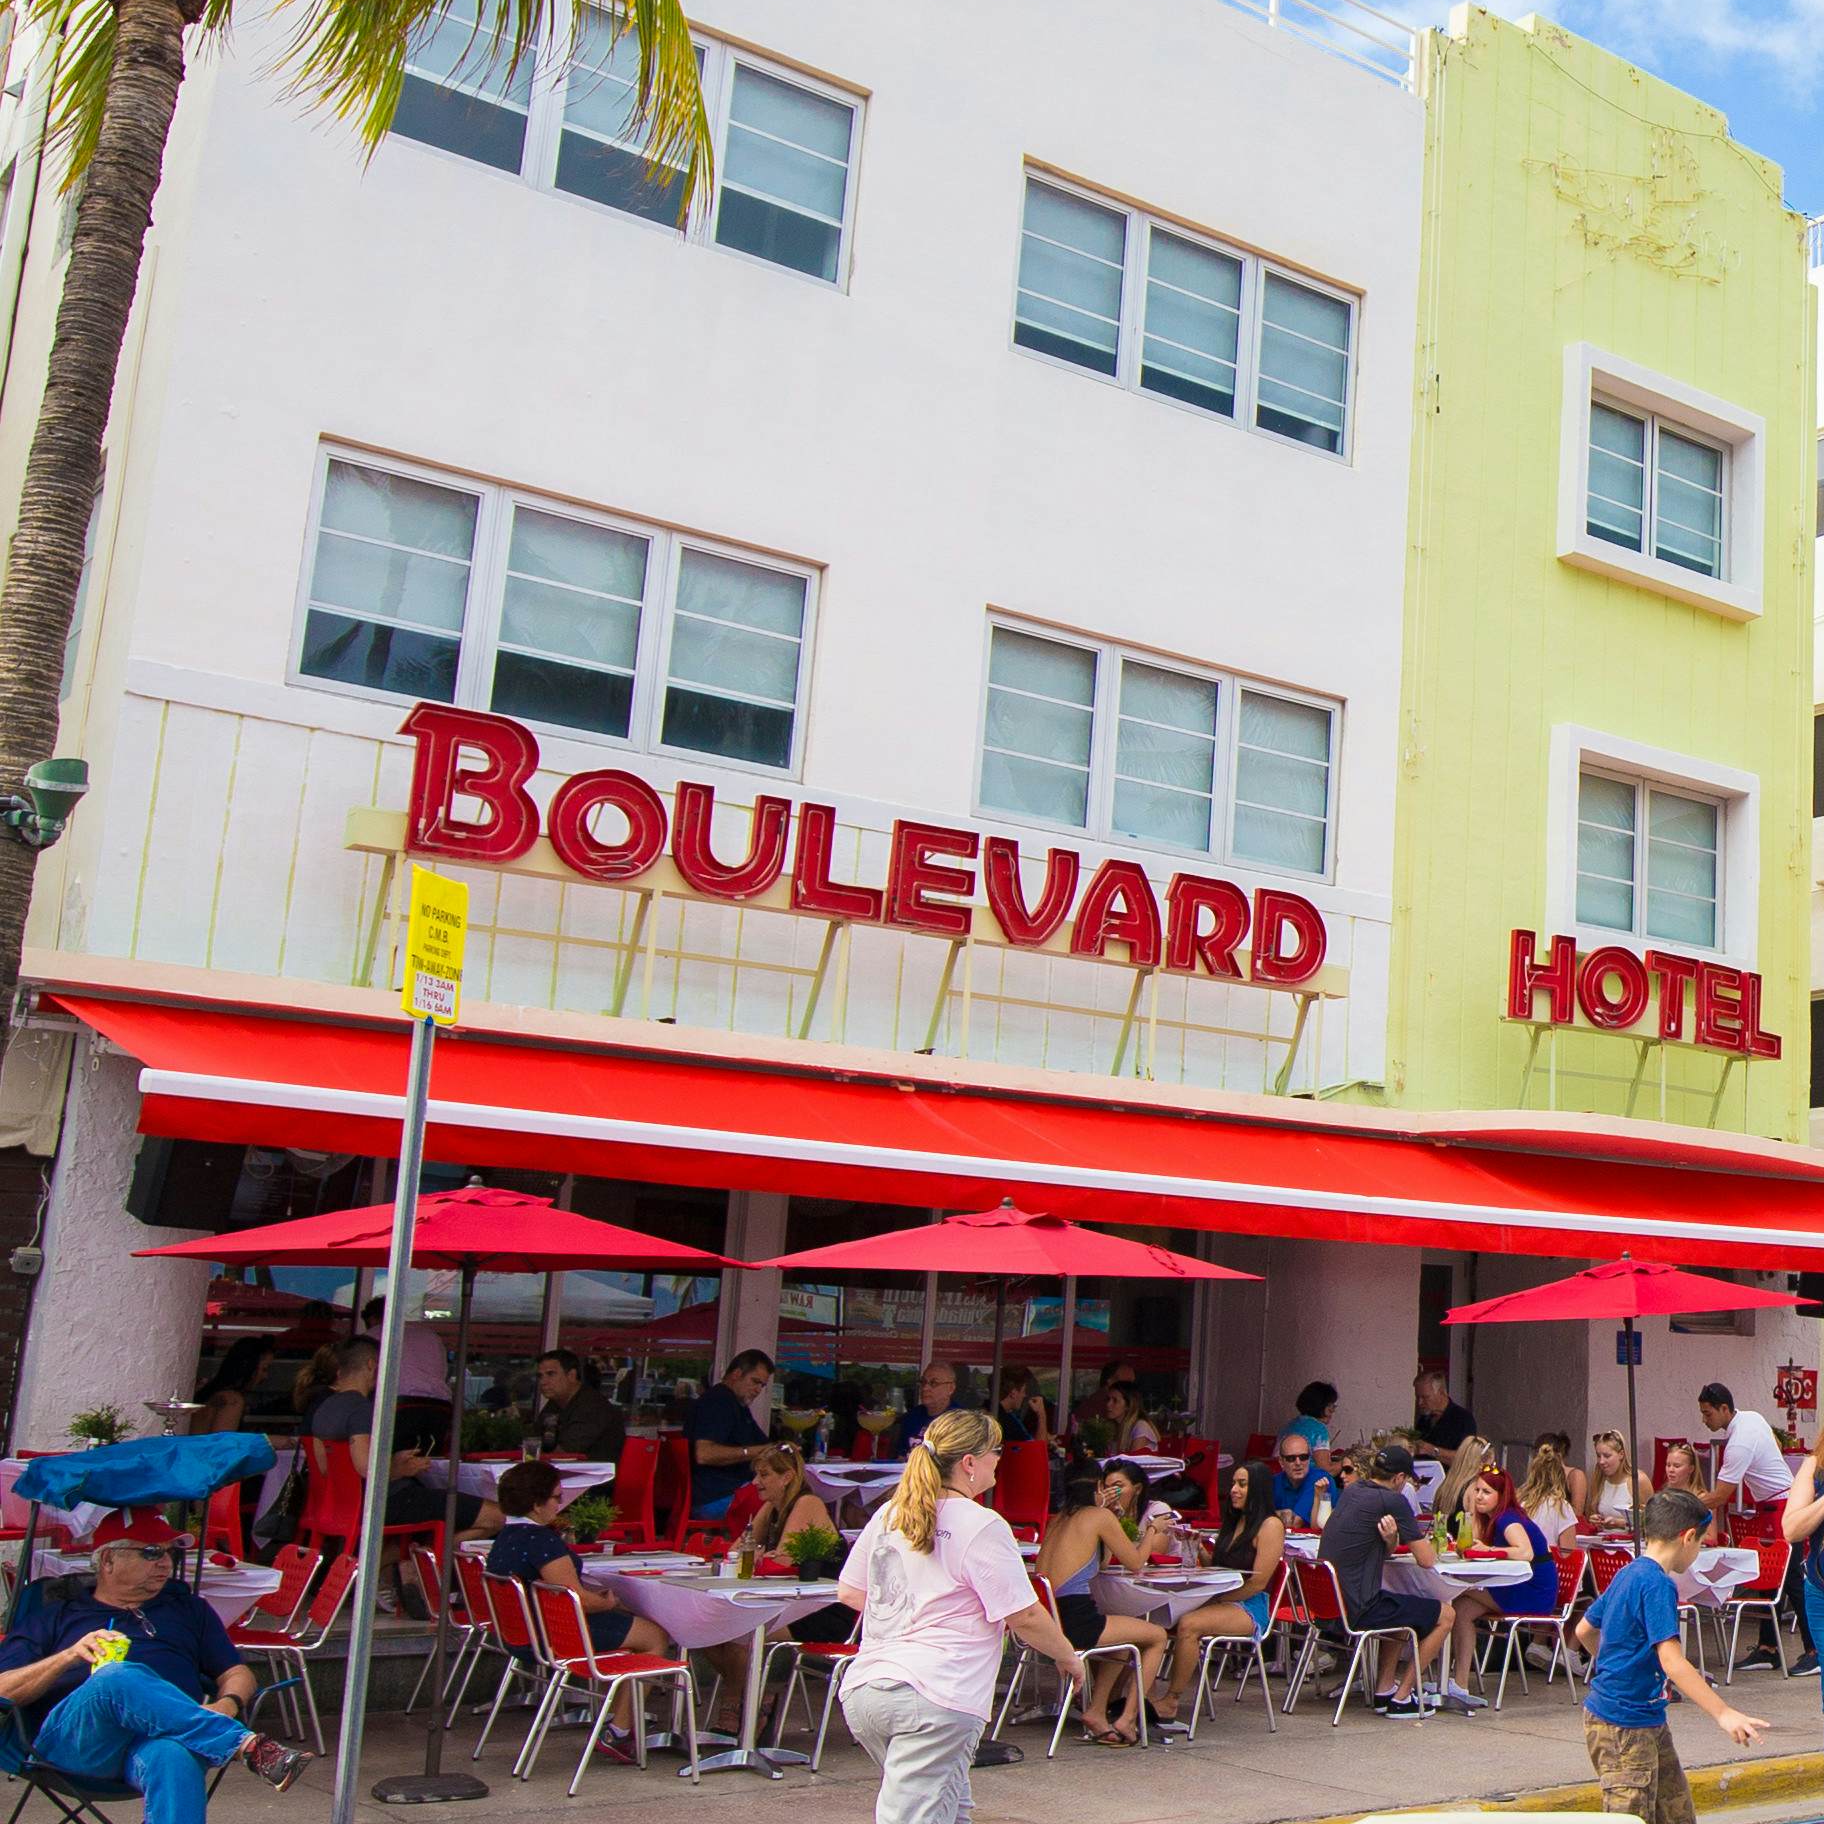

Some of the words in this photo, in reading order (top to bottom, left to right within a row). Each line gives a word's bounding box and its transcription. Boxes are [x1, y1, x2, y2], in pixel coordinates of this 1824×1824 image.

[397, 702, 1326, 985] BOULEVARD
[421, 903, 431, 918] NO
[432, 906, 462, 928] PARKING
[423, 987, 446, 1003] THRU
[1507, 929, 1782, 1060] HOTEL
